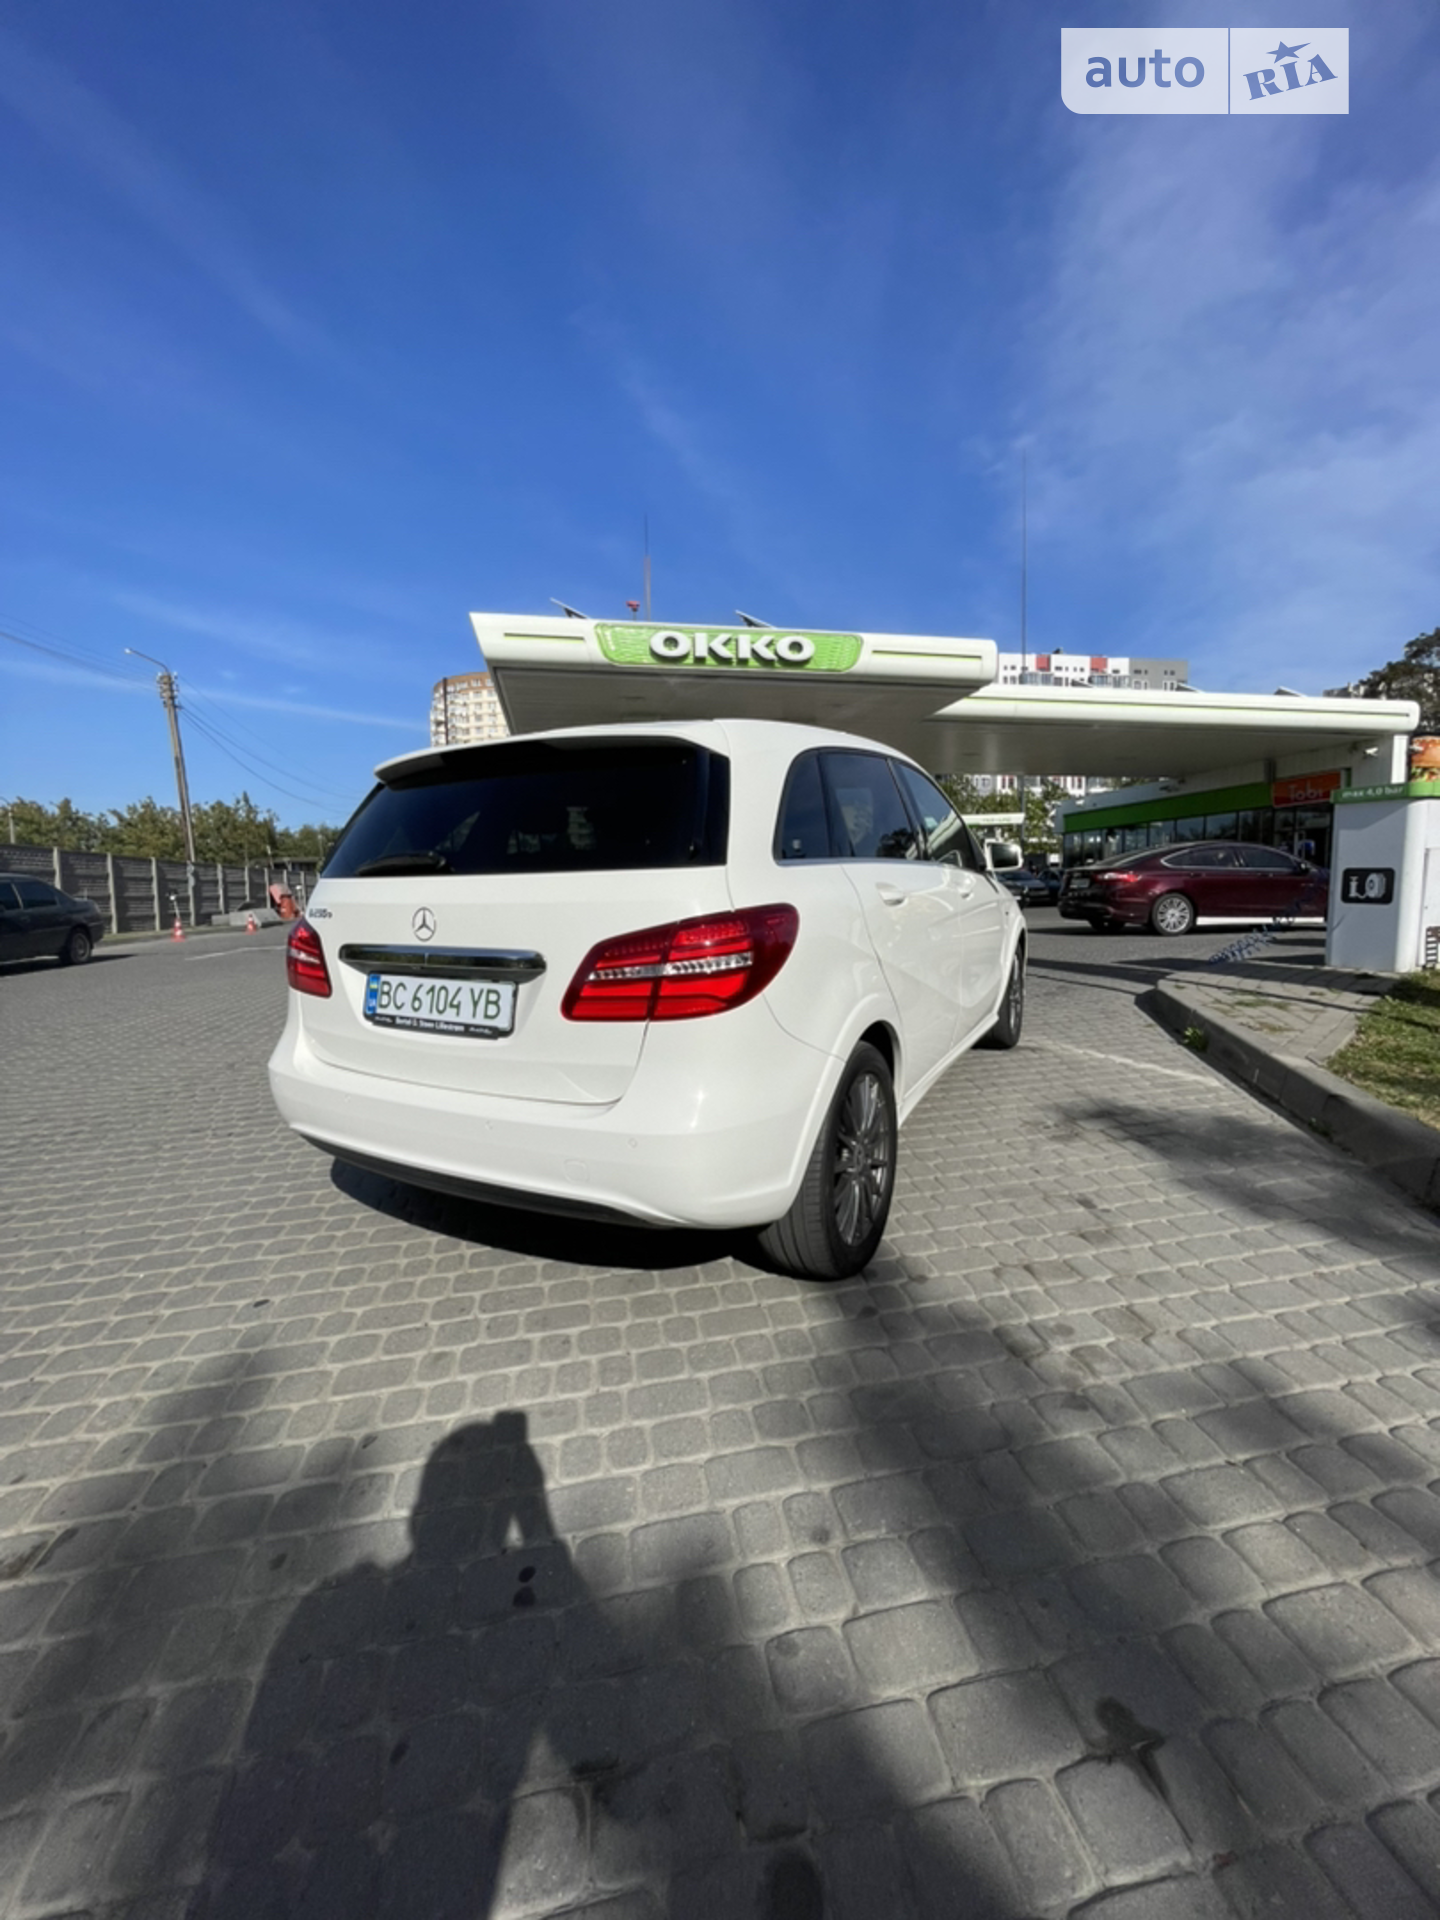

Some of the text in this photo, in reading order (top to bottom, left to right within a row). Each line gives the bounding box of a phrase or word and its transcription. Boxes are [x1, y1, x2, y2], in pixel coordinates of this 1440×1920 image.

[650, 631, 815, 662] OKKO
[378, 980, 502, 1020] BC 6104 YB
